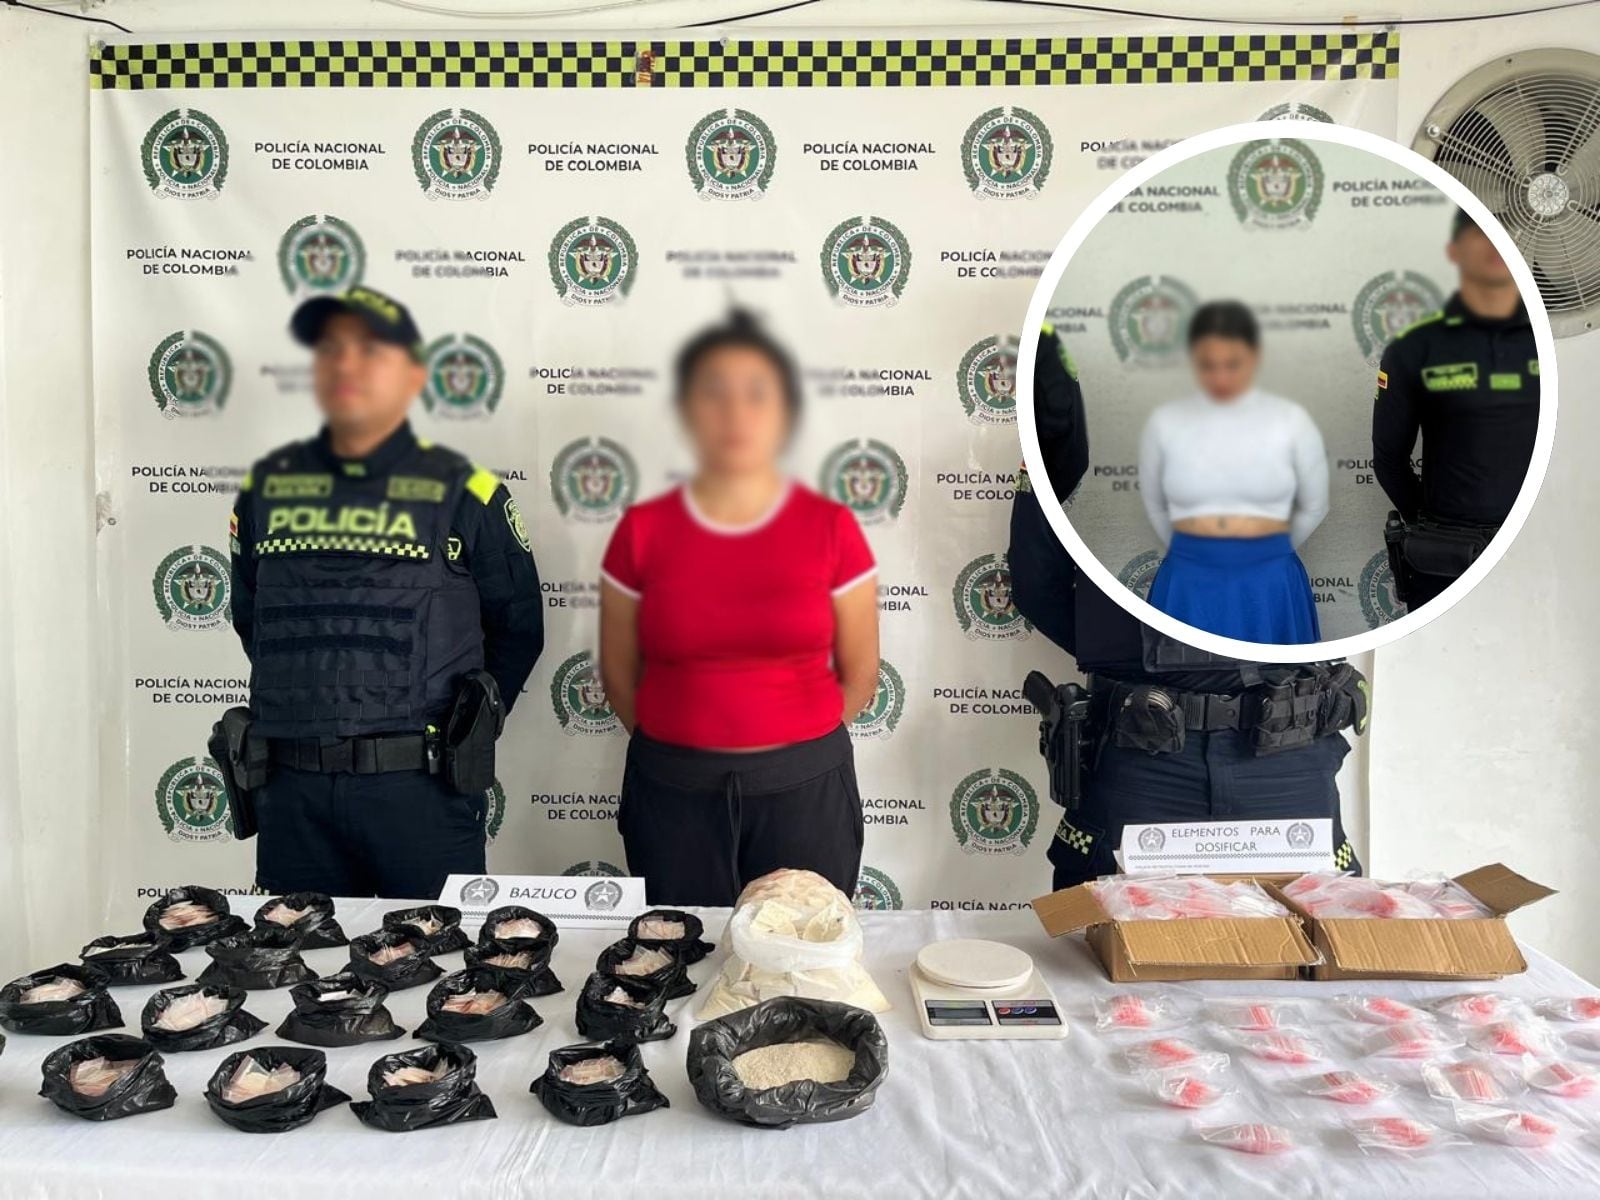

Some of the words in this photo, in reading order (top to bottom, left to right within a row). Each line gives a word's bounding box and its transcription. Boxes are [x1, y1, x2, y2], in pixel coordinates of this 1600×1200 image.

[255, 141, 309, 153] POLICÍA
[314, 143, 385, 154] NACIONAL
[528, 141, 583, 155] POLICÍA
[587, 143, 659, 155] NACIONAL
[803, 141, 858, 154] POLICÍA
[863, 143, 935, 155] NACIONAL
[272, 159, 290, 170] DE
[295, 160, 368, 170] COLOMBIA
[545, 160, 564, 171] DE
[567, 160, 642, 172] COLOMBIA
[820, 160, 840, 171] DE
[843, 160, 917, 171] COLOMBIA
[127, 247, 177, 259] POLICÍA
[181, 249, 253, 261] NACIONAL
[941, 249, 996, 262] POLICÍA
[143, 264, 159, 275] DE
[162, 264, 238, 277] COLOMBIA
[958, 267, 976, 277] DE
[547, 384, 565, 394] DE
[132, 465, 186, 477] POLICÍA
[937, 471, 992, 484] POLICÍA
[1356, 474, 1374, 484] DE
[150, 482, 168, 492] DE
[954, 490, 972, 500] DE
[976, 490, 1014, 500] COLO
[268, 502, 416, 539] POLICÍA
[1128, 564, 1150, 588] UBLICA
[1311, 577, 1353, 588] IONAL
[549, 597, 567, 607] DE
[136, 675, 190, 688] POLICÍA
[194, 679, 250, 688] NACION
[153, 693, 172, 703] DE
[175, 693, 248, 704] COLOMBIA
[934, 686, 988, 699] POLICÍA
[950, 704, 968, 714] DE
[531, 792, 585, 804] POLICÍA
[548, 810, 566, 820] DE
[570, 810, 618, 820] COLOM
[864, 815, 908, 824] OMBIA
[1172, 827, 1238, 838] ELEMENTOS
[1251, 826, 1280, 836] PARA
[1196, 842, 1257, 852] DOSIFICAR
[510, 887, 576, 900] BAZUCO
